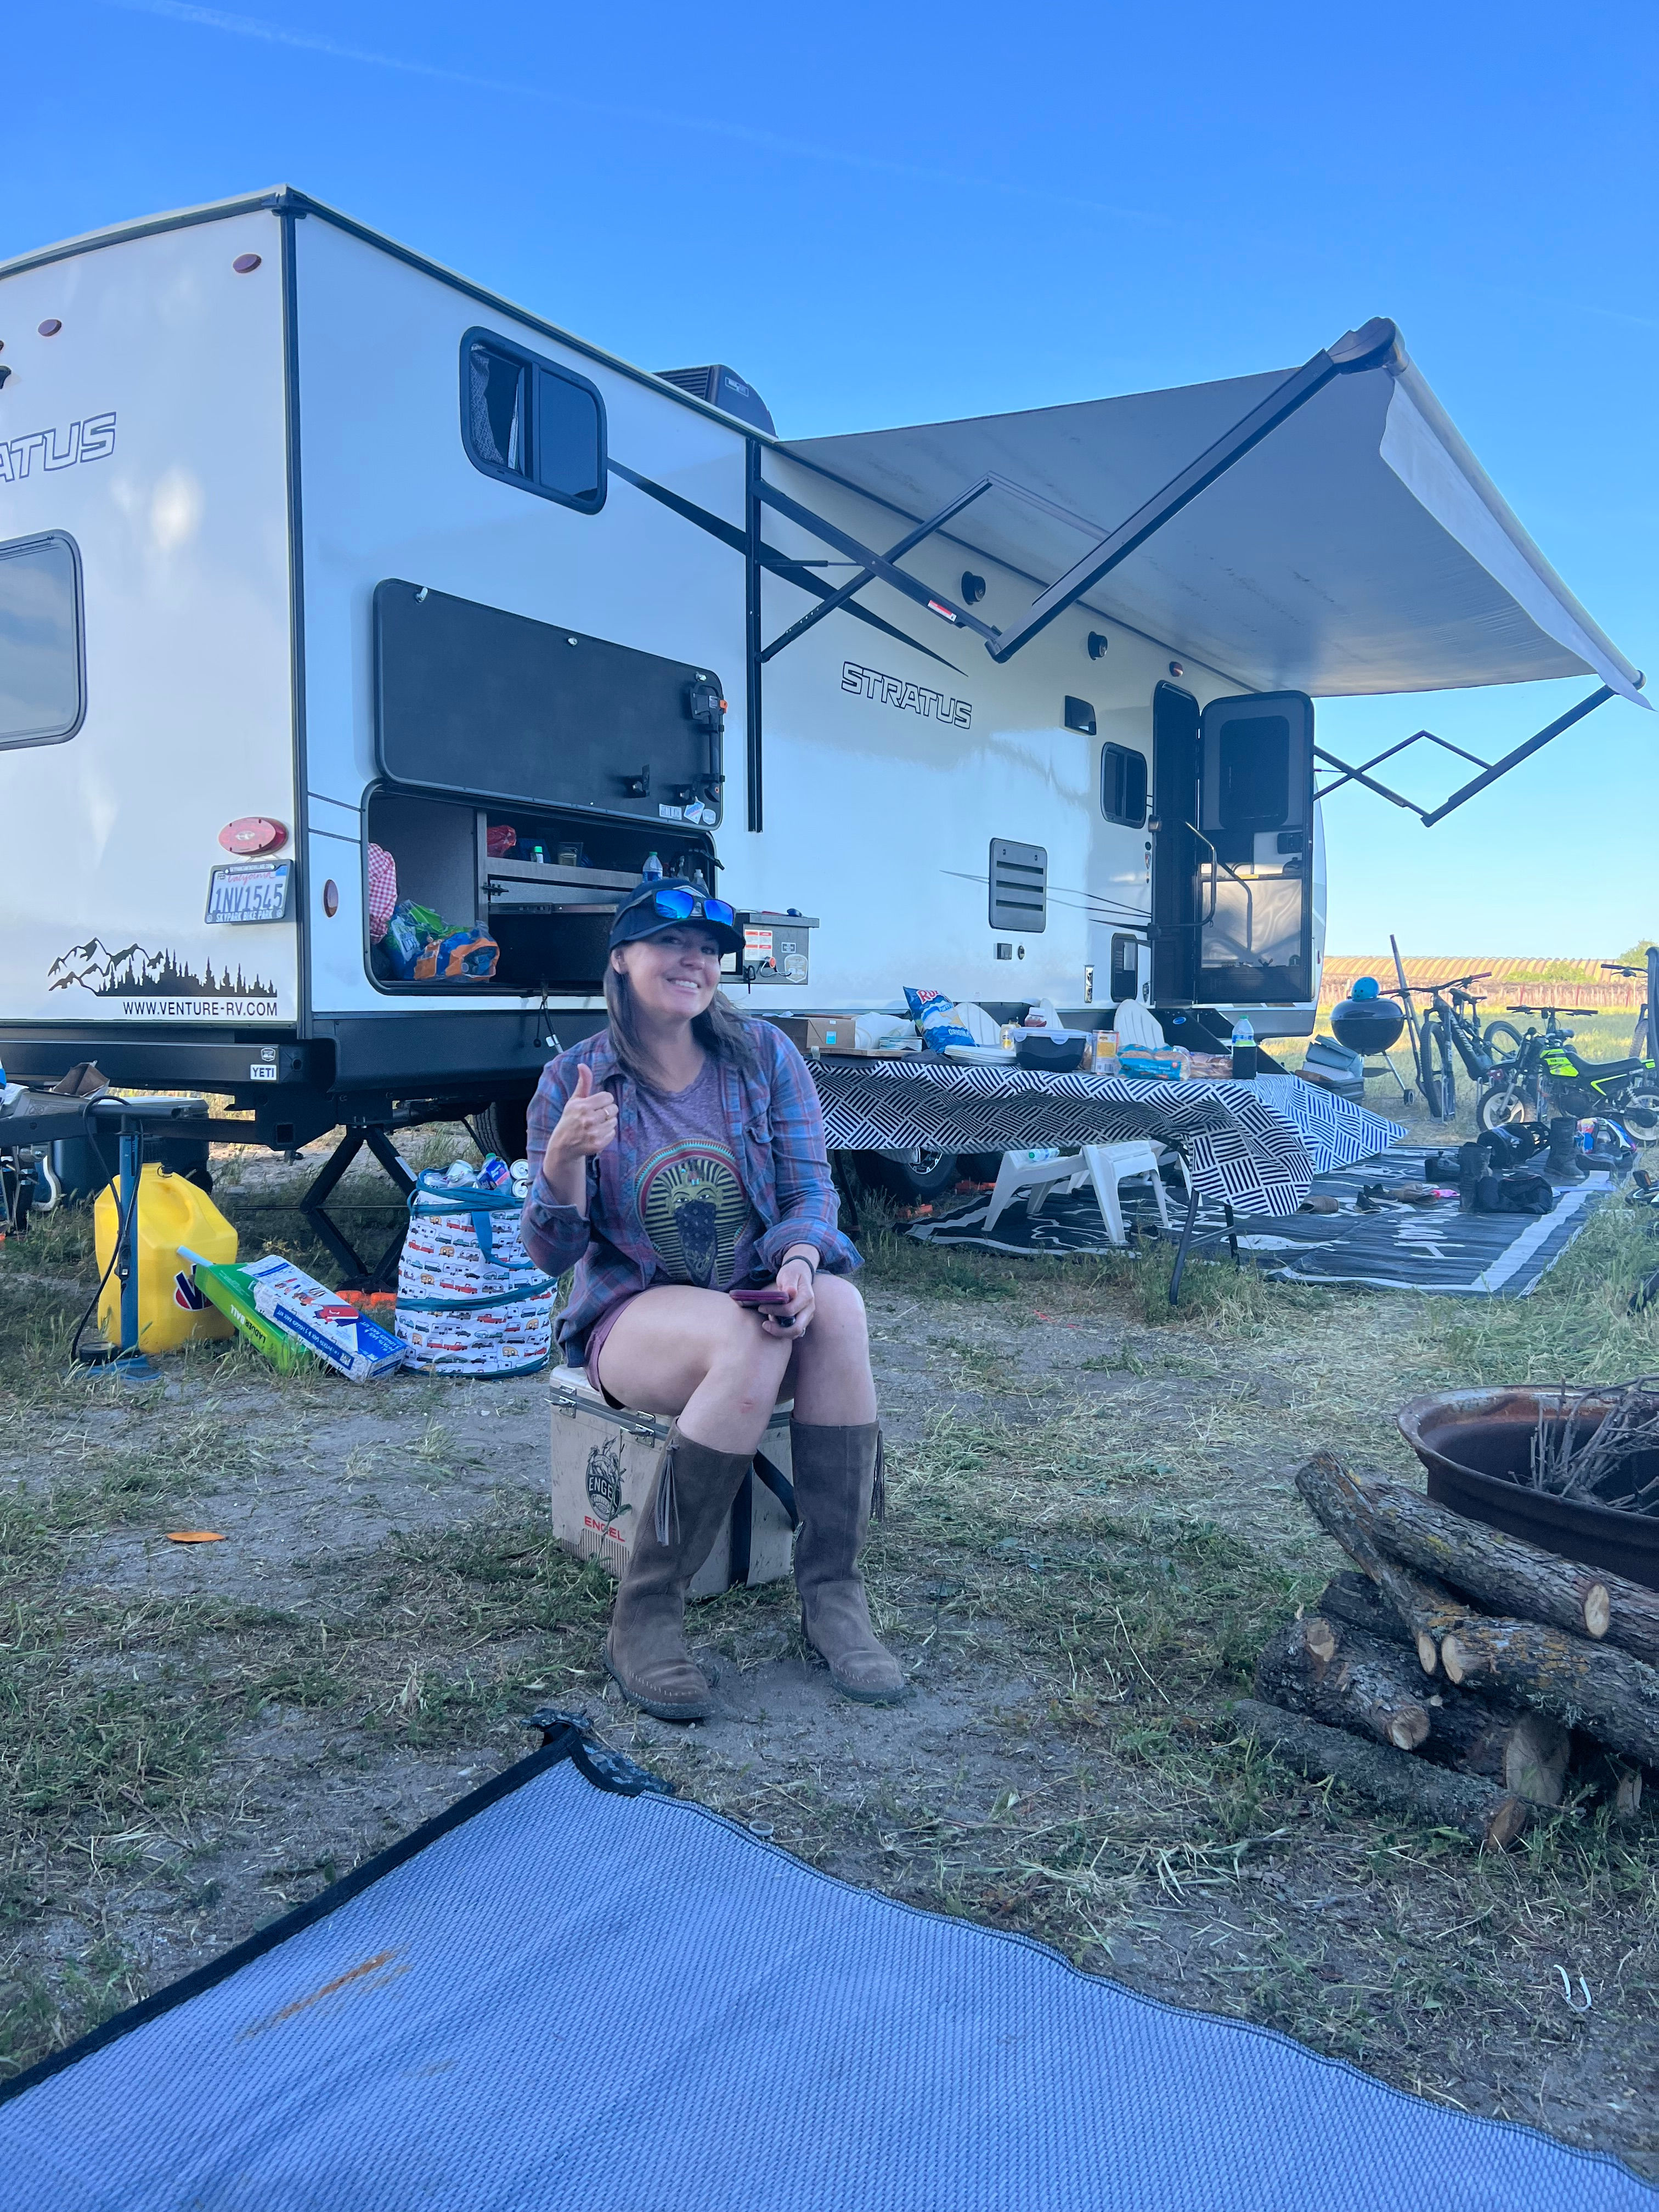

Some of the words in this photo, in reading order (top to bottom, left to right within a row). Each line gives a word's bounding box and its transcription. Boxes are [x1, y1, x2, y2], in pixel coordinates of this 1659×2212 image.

[842, 661, 972, 729] STRATUS
[216, 884, 283, 912] 1NV1545
[216, 912, 242, 922] SKYPARK
[243, 910, 257, 921] BIKE
[258, 909, 273, 919] PARK
[123, 1002, 277, 1015] WWW.VENTURE-RV.COM
[252, 1067, 274, 1078] YETI
[231, 1304, 245, 1324] BALL
